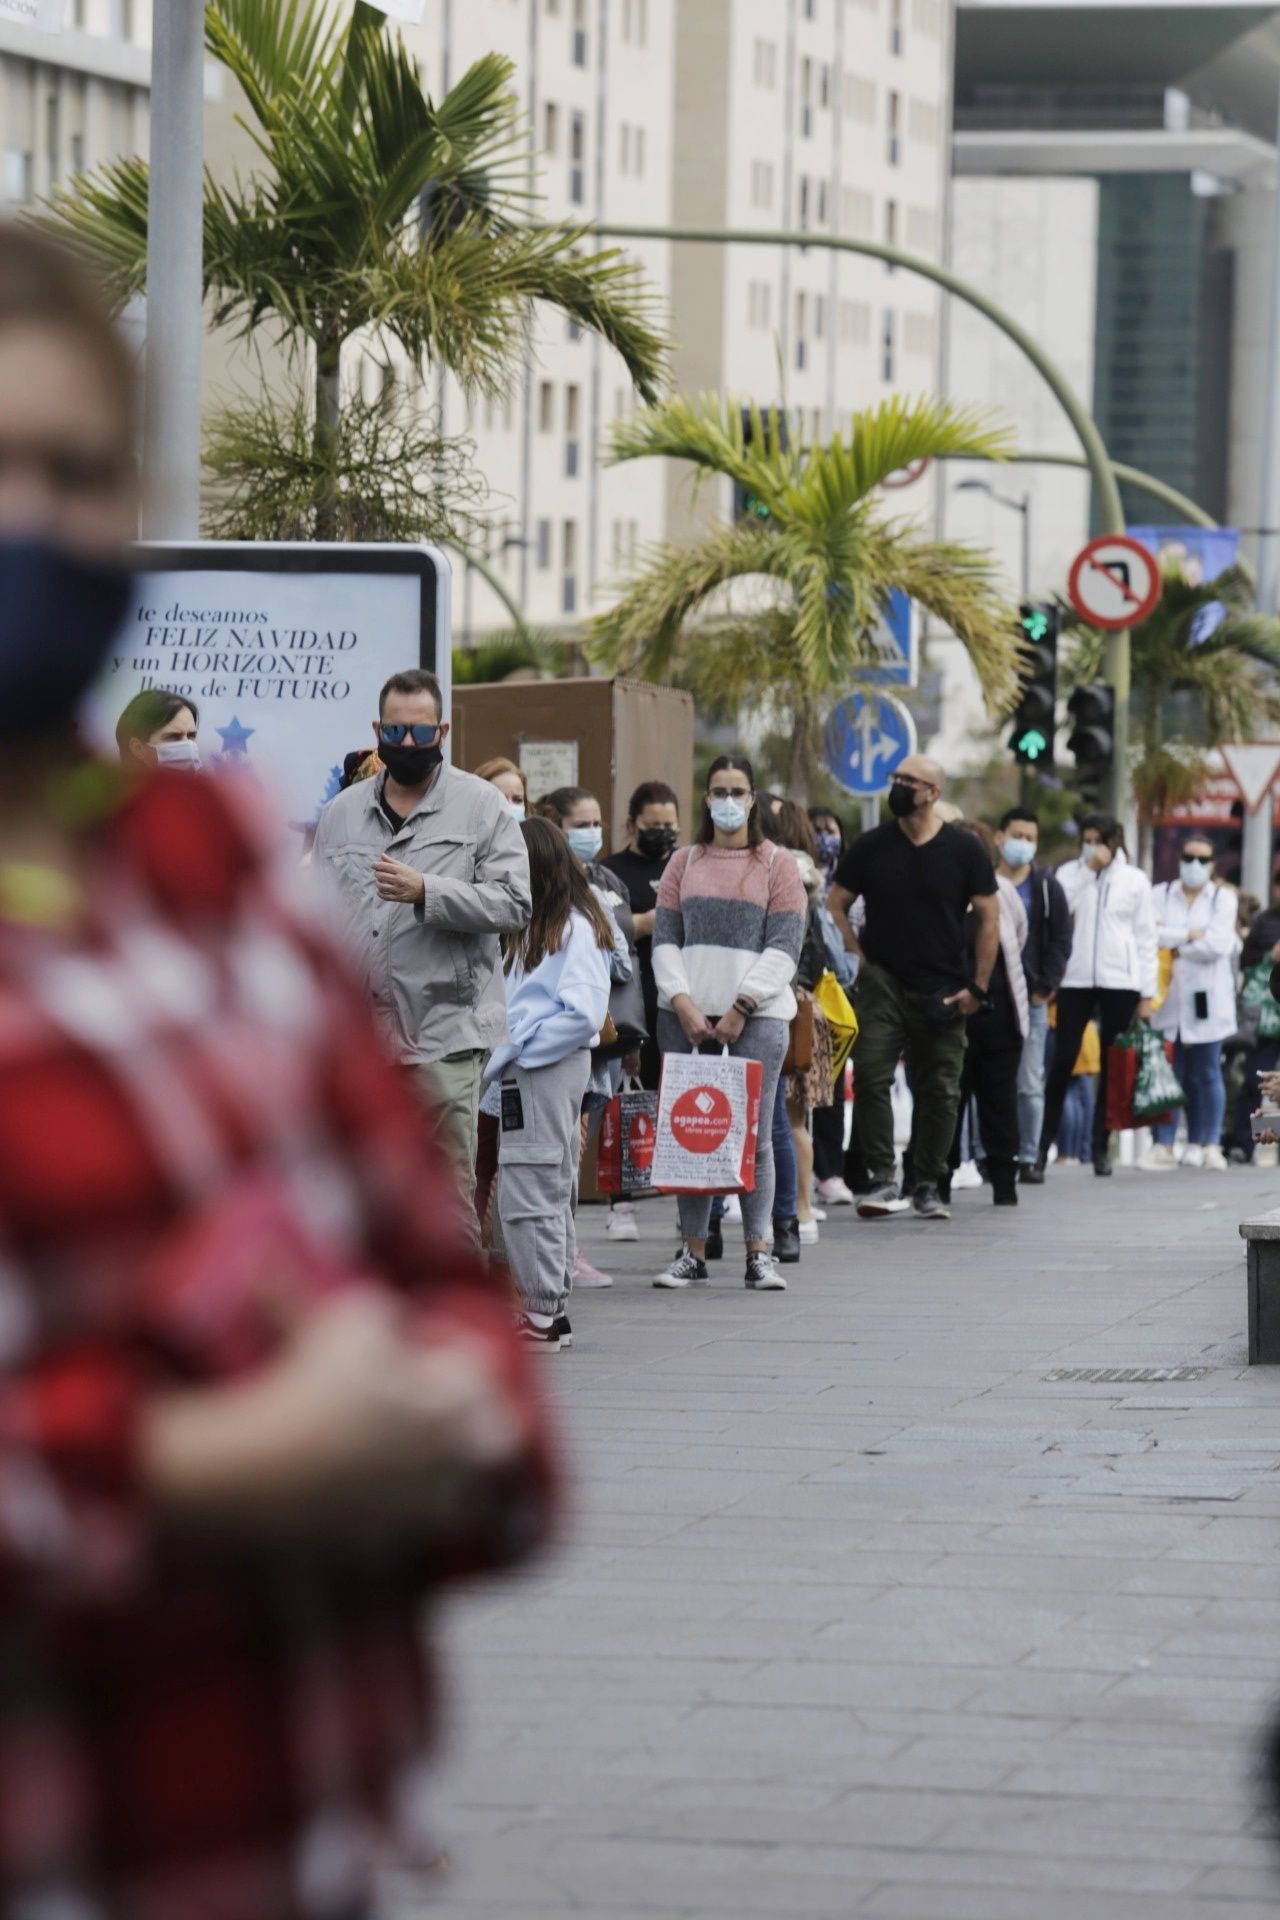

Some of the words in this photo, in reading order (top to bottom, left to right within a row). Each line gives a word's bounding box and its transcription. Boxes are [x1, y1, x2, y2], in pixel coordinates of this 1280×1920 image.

[137, 605, 156, 623] te
[165, 603, 269, 624] deseamos
[145, 627, 218, 648] FELIZ
[227, 629, 358, 651] NAVIDAD
[133, 656, 160, 671] un
[170, 652, 335, 675] HORIZONTE
[201, 678, 227, 698] de
[235, 679, 351, 700] FUTURO
[673, 1115, 729, 1128] agapea.com
